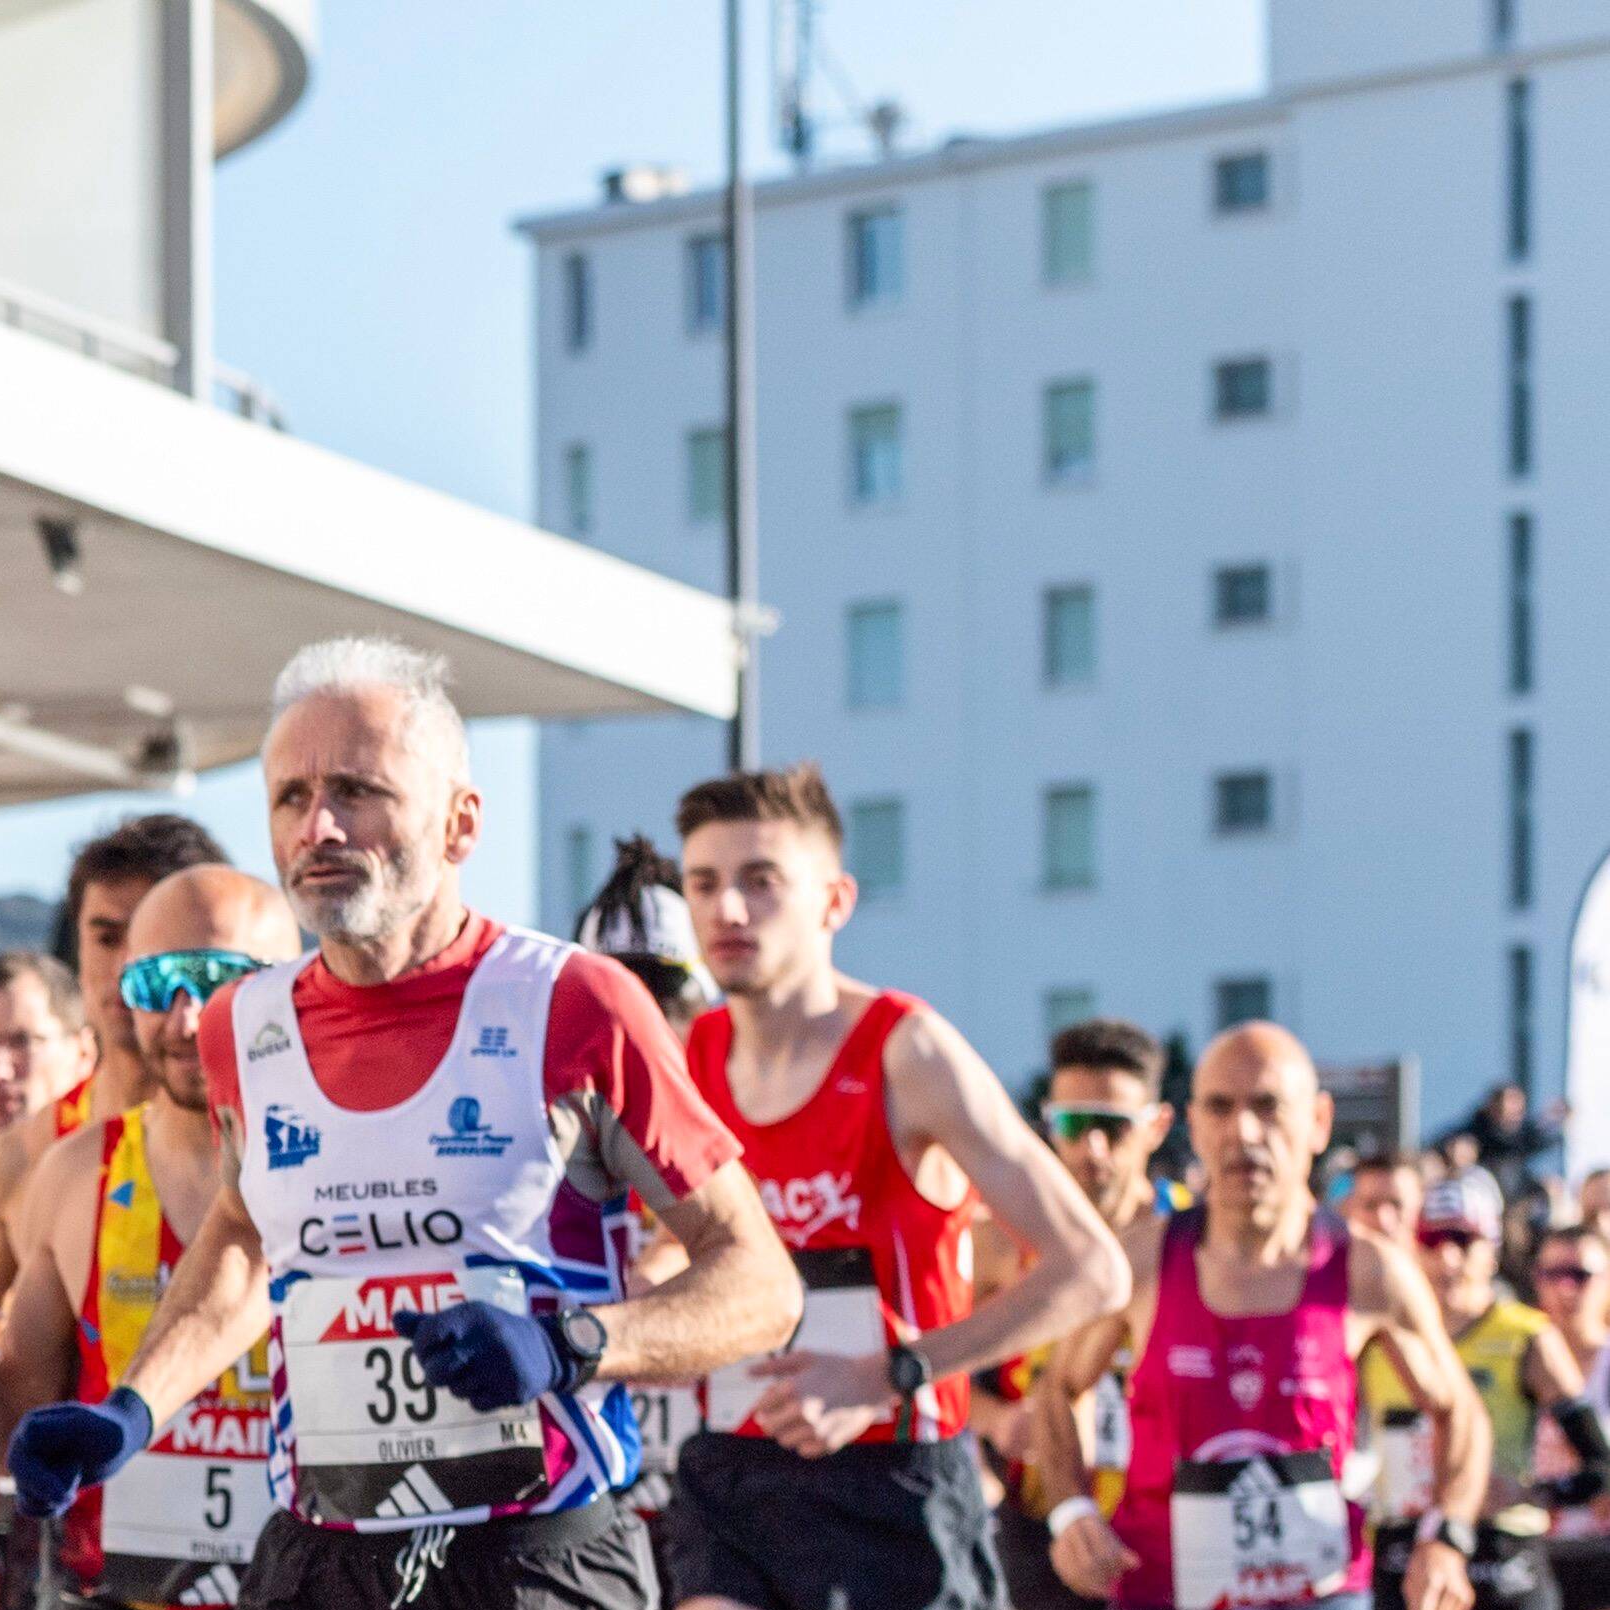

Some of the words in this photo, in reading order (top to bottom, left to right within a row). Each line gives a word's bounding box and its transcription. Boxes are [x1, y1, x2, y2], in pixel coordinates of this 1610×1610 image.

[314, 1178, 439, 1202] MEUBLES
[299, 1210, 465, 1257] CELIO
[364, 1346, 438, 1426] 39
[205, 1466, 232, 1530] 5
